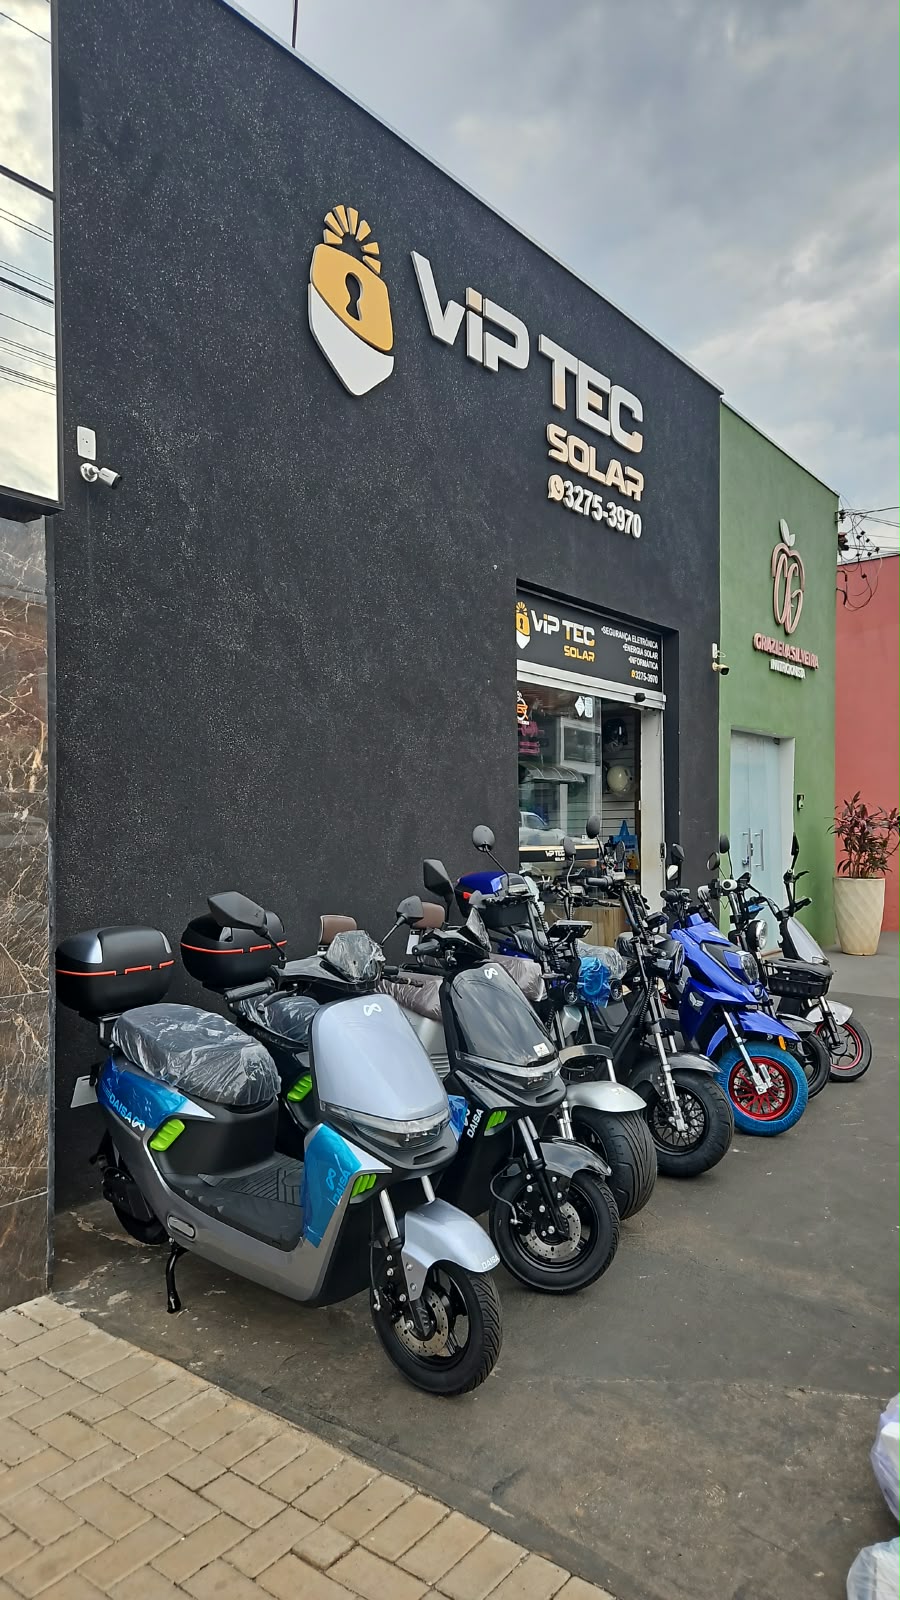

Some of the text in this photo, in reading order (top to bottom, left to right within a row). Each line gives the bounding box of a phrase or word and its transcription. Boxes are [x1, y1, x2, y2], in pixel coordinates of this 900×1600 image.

[538, 333, 644, 453] TEC
[546, 423, 645, 501] SOLAR
[562, 480, 643, 539] 3275-3970
[561, 619, 596, 647] TEC
[601, 625, 632, 643] SEGURANÇA
[563, 645, 595, 663] SOLAR
[624, 643, 659, 660] ENERGIA SOLAR
[629, 655, 659, 670] INFORMÁTICA
[634, 670, 659, 684] 3275-3970
[109, 1092, 132, 1123] DAISA
[466, 1108, 485, 1139] DAISA
[332, 1170, 351, 1205] DAISA
[481, 1254, 500, 1270] DAISA
